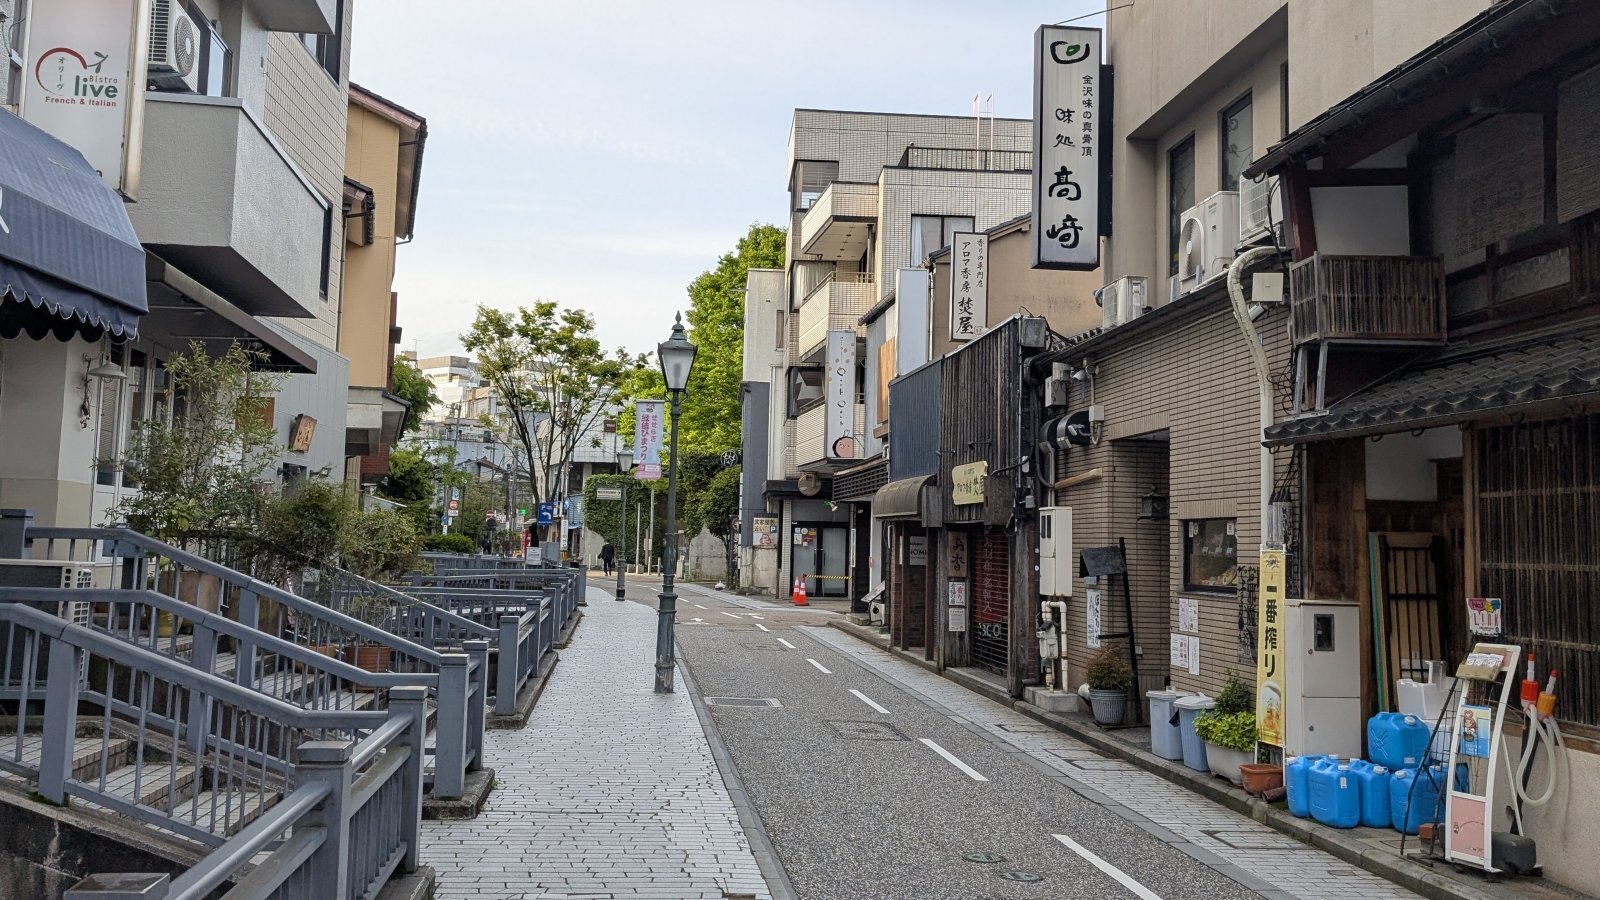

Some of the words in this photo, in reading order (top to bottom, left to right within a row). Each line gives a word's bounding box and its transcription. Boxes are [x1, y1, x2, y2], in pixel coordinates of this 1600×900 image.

[45, 96, 75, 105] French
[79, 97, 86, 105] &
[88, 98, 117, 107] Italian
[89, 74, 118, 84] Bistro
[1081, 74, 1094, 157] 金沢味の真骨頂
[976, 238, 985, 288] 香りの専門店
[640, 413, 650, 461] 縁結びまつり
[1264, 585, 1278, 678] 一番搾り
